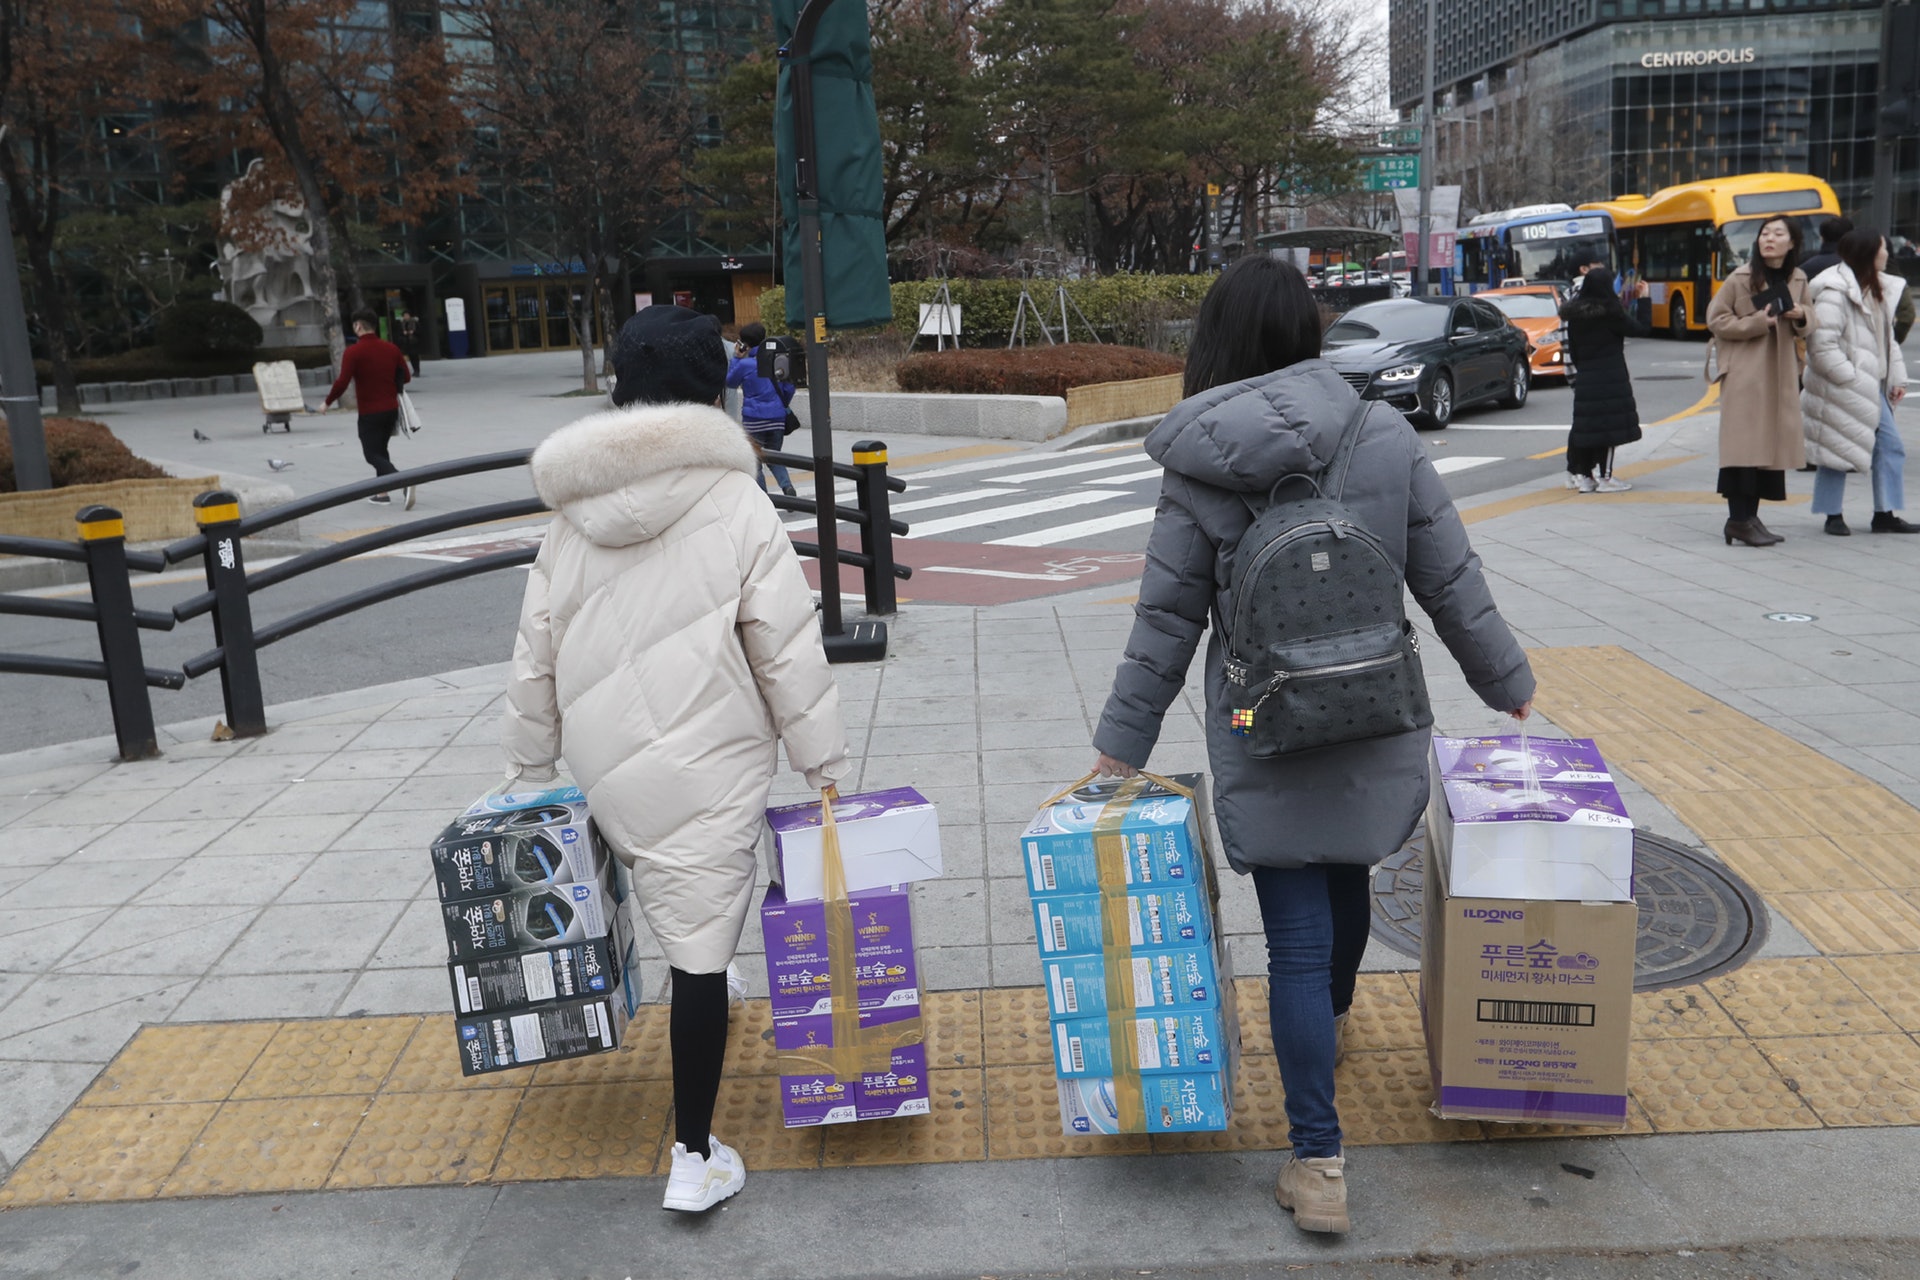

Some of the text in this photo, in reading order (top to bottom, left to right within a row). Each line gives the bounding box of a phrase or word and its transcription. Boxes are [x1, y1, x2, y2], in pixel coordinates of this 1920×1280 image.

[1641, 47, 1755, 68] CENTROPOLIS
[1522, 224, 1547, 240] 109
[1588, 813, 1621, 824] KF-94
[1164, 830, 1181, 864] 자연숲
[452, 848, 474, 891] 자연숲
[1175, 891, 1192, 925] 자연숲
[1463, 908, 1524, 922] ILDONG
[463, 906, 486, 949] 자연숲
[858, 926, 891, 935] WINNER
[784, 933, 816, 943] WINNER
[584, 944, 601, 976] 자연숲
[1480, 939, 1559, 969] 푸른숲
[778, 969, 813, 986] 푸른숲
[852, 961, 887, 978] 푸른숲
[1186, 952, 1203, 986] 자연숲
[1481, 970, 1596, 985] 미세먼지 황사 마스크
[1192, 1015, 1209, 1049] 자연숲
[1499, 1059, 1541, 1069] ILDONG
[1543, 1060, 1577, 1069] 일동제약
[790, 1079, 825, 1096] 푸른숲
[863, 1072, 898, 1088] 푸른숲
[1181, 1079, 1204, 1123] 자연숲
[831, 1111, 853, 1119] KF-94
